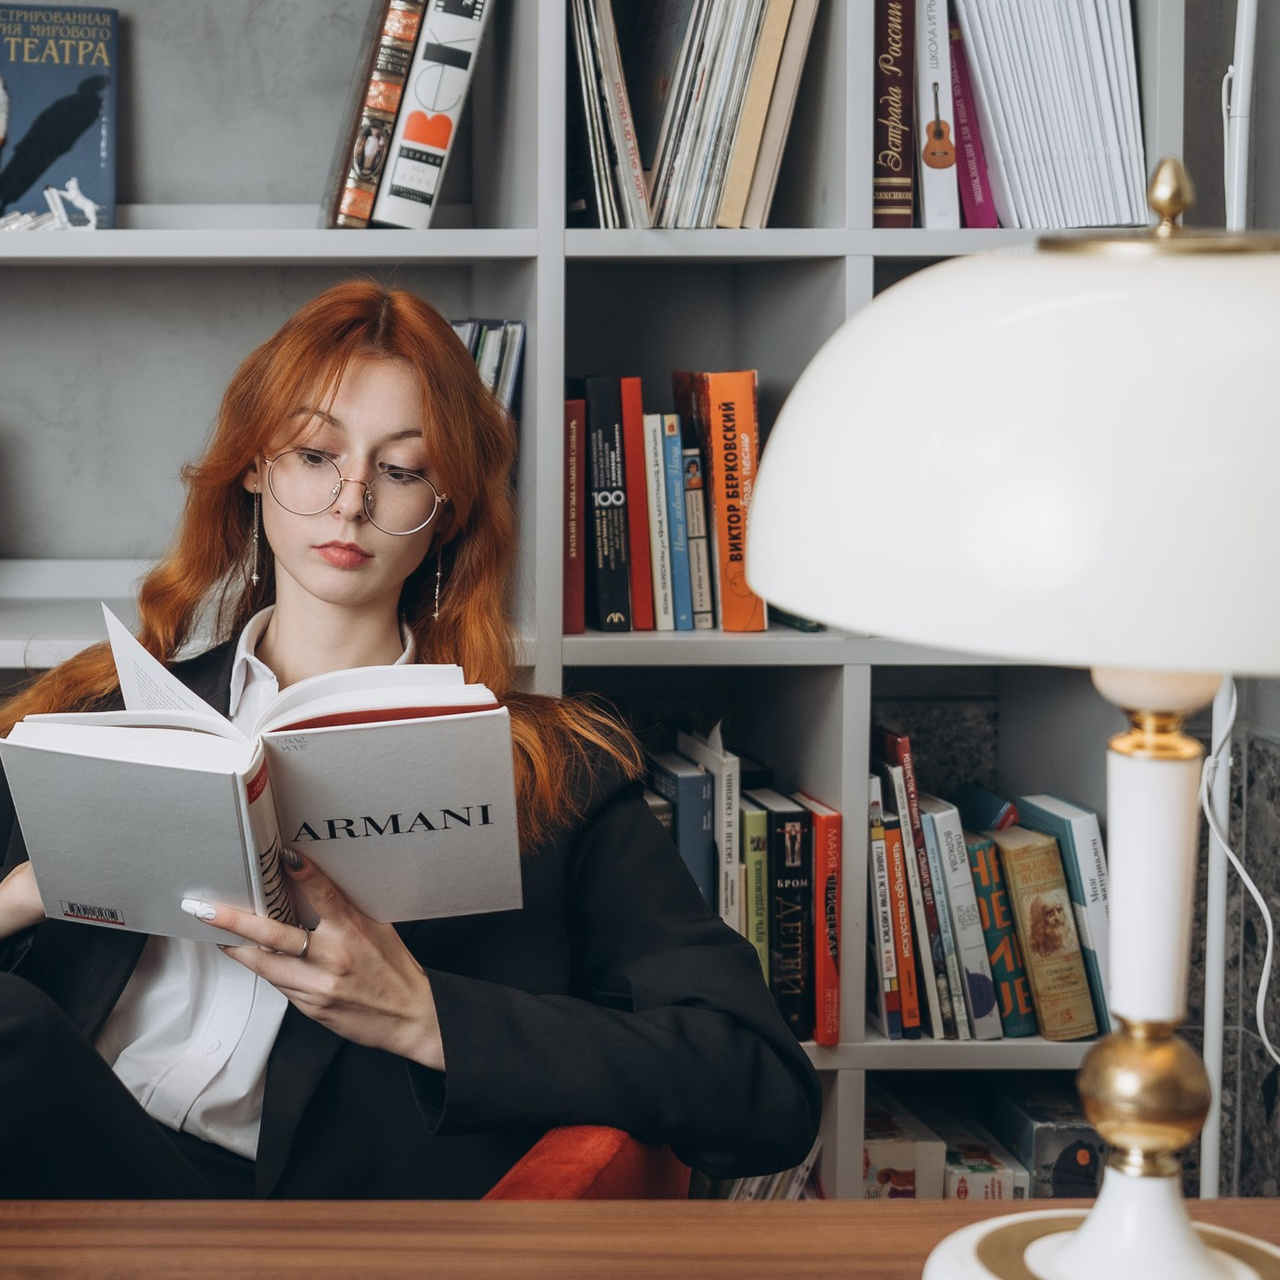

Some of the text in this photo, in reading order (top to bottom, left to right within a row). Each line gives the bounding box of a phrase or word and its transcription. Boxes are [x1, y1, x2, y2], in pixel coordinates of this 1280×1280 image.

[3, 37, 111, 67] ТЕАТРА
[29, 24, 111, 40] МИРОВОГО
[927, 28, 939, 68] ШКОЛА
[875, 2, 909, 171] Эстрада России
[567, 419, 578, 557] КРАТКИЙ МУЗЫКАЛЬНЫЙ СЛОВАРЬ
[591, 490, 625, 508] 100
[718, 401, 744, 561] ВИКТОР БЕРКОВСКИЙ
[673, 524, 685, 552] Наши
[291, 803, 495, 843] ARMANI
[826, 827, 839, 869] МАЙЯ
[944, 829, 958, 874] ВОЛКОВА
[955, 833, 967, 865] ПАОЛА
[777, 878, 809, 888] БРОМ
[824, 870, 839, 958] ПЛИСЕЦКАЯ
